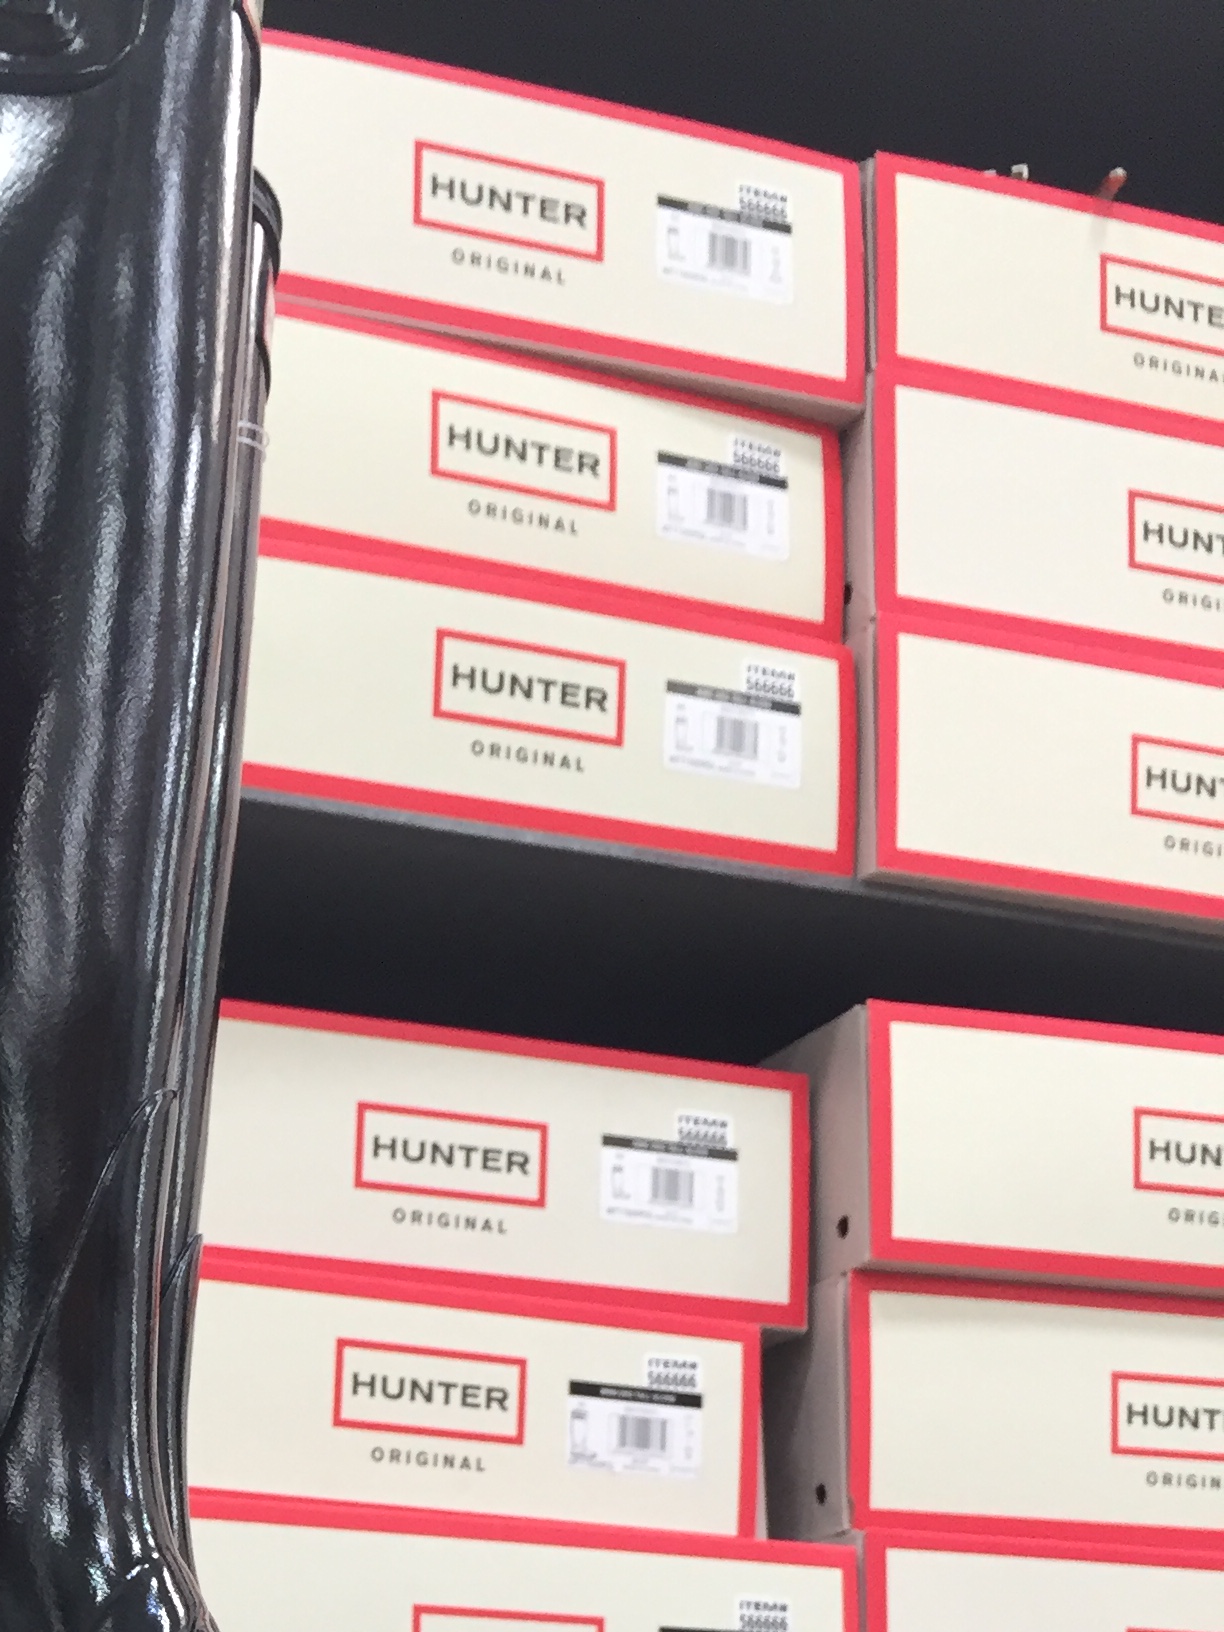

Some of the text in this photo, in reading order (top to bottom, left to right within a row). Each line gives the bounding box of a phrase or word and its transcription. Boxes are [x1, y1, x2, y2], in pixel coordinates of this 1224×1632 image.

[431, 174, 586, 228] HUNTER
[452, 248, 564, 285] ORIGINAL
[1115, 285, 1224, 329] HUNTE
[1134, 353, 1224, 382] ORIGINA
[448, 424, 600, 478] HUNTER
[468, 499, 577, 536] ORIGINAL
[452, 664, 608, 712] HUNTER
[471, 740, 583, 772] ORIGINAL
[1146, 766, 1224, 798] HUN
[373, 1135, 529, 1175] HUNTER
[1149, 1139, 1222, 1166] HUN
[393, 1208, 507, 1234] ORIGINAL
[1168, 1208, 1224, 1227] ORIG
[352, 1372, 508, 1411] HUNTER
[1127, 1403, 1224, 1431] HUNT
[371, 1447, 485, 1472] ORIGINAL
